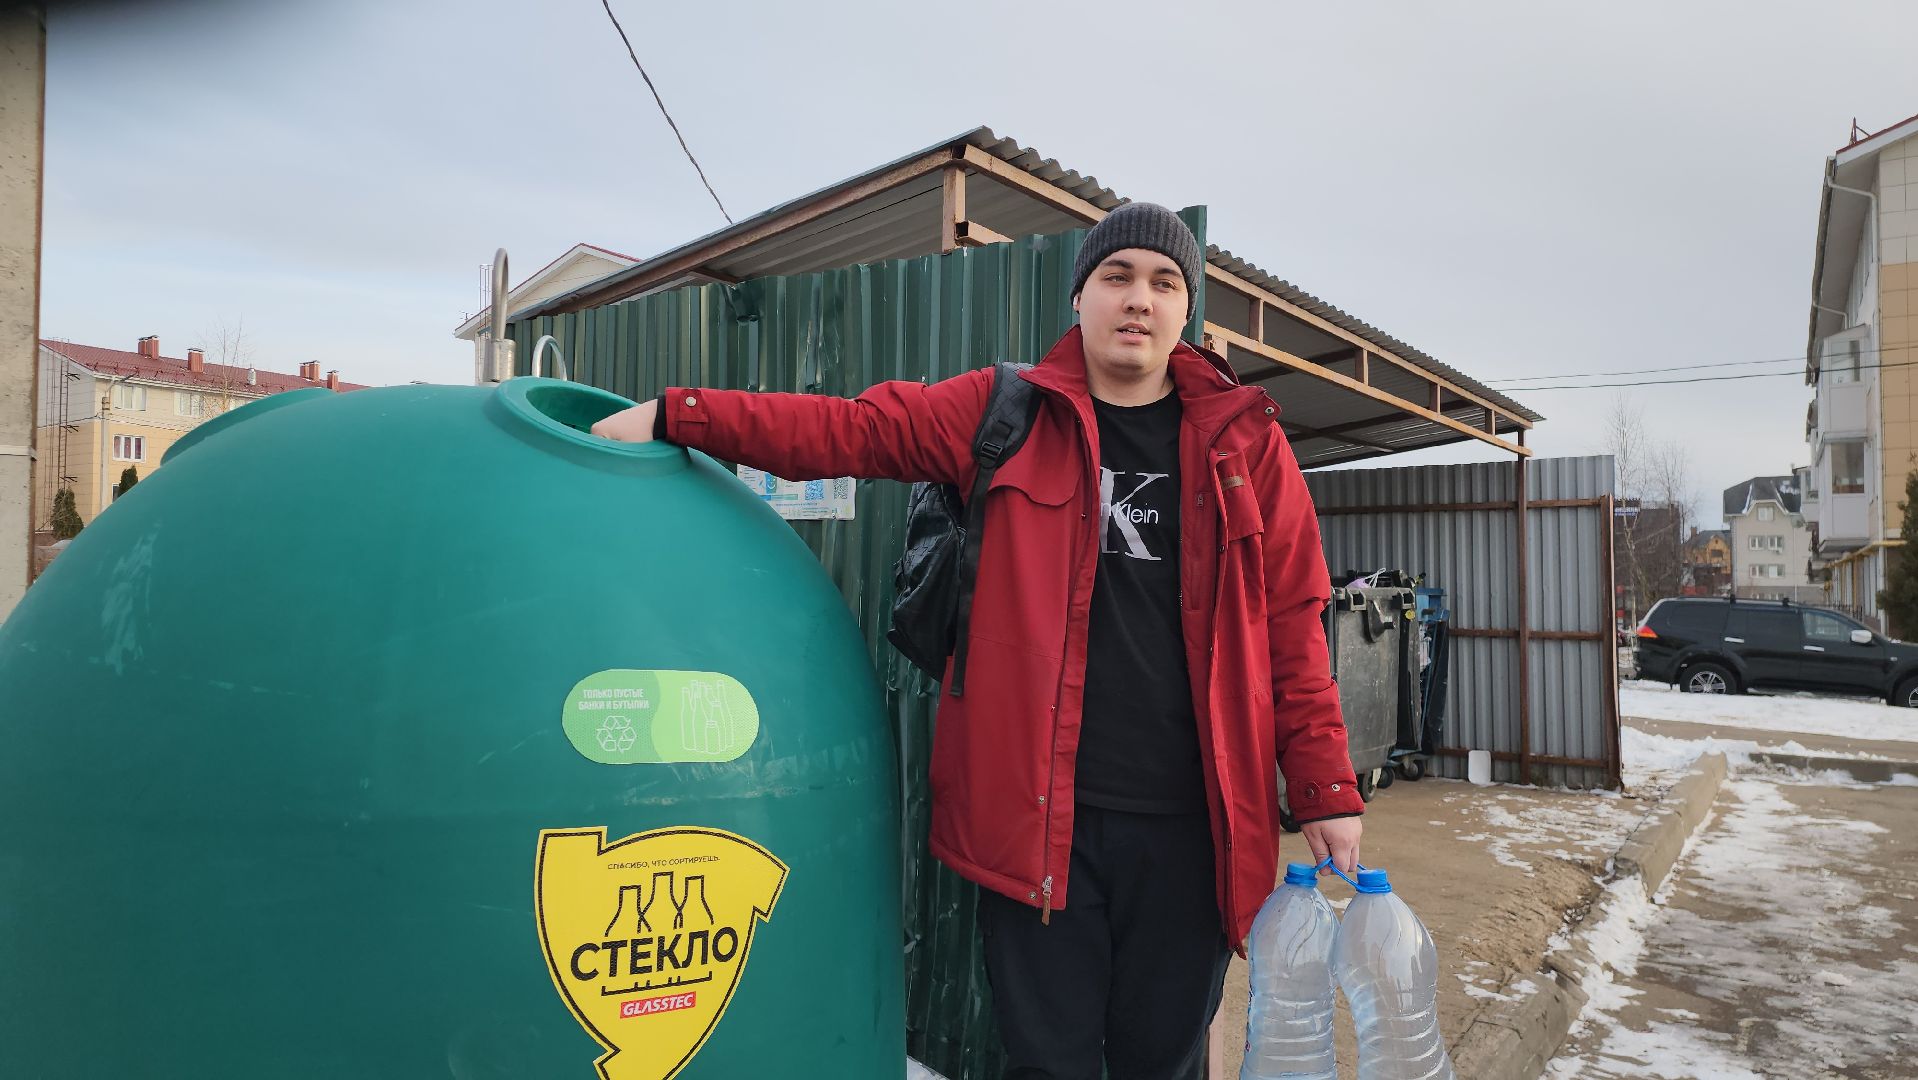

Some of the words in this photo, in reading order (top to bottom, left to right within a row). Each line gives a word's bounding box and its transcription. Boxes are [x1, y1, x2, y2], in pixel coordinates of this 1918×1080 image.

[1114, 501, 1159, 525] Klein
[583, 689, 612, 699] ТОЛЬКО
[613, 688, 644, 698] ПУСТЫЕ
[578, 701, 605, 711] БАНКИ
[606, 700, 612, 710] И
[612, 700, 650, 710] БУТЫЛКИ
[607, 861, 650, 870] СПАСИБО,
[651, 859, 667, 867] ЧТО
[570, 926, 739, 982] СТЕКЛО
[623, 993, 694, 1016] GLASSTEC
